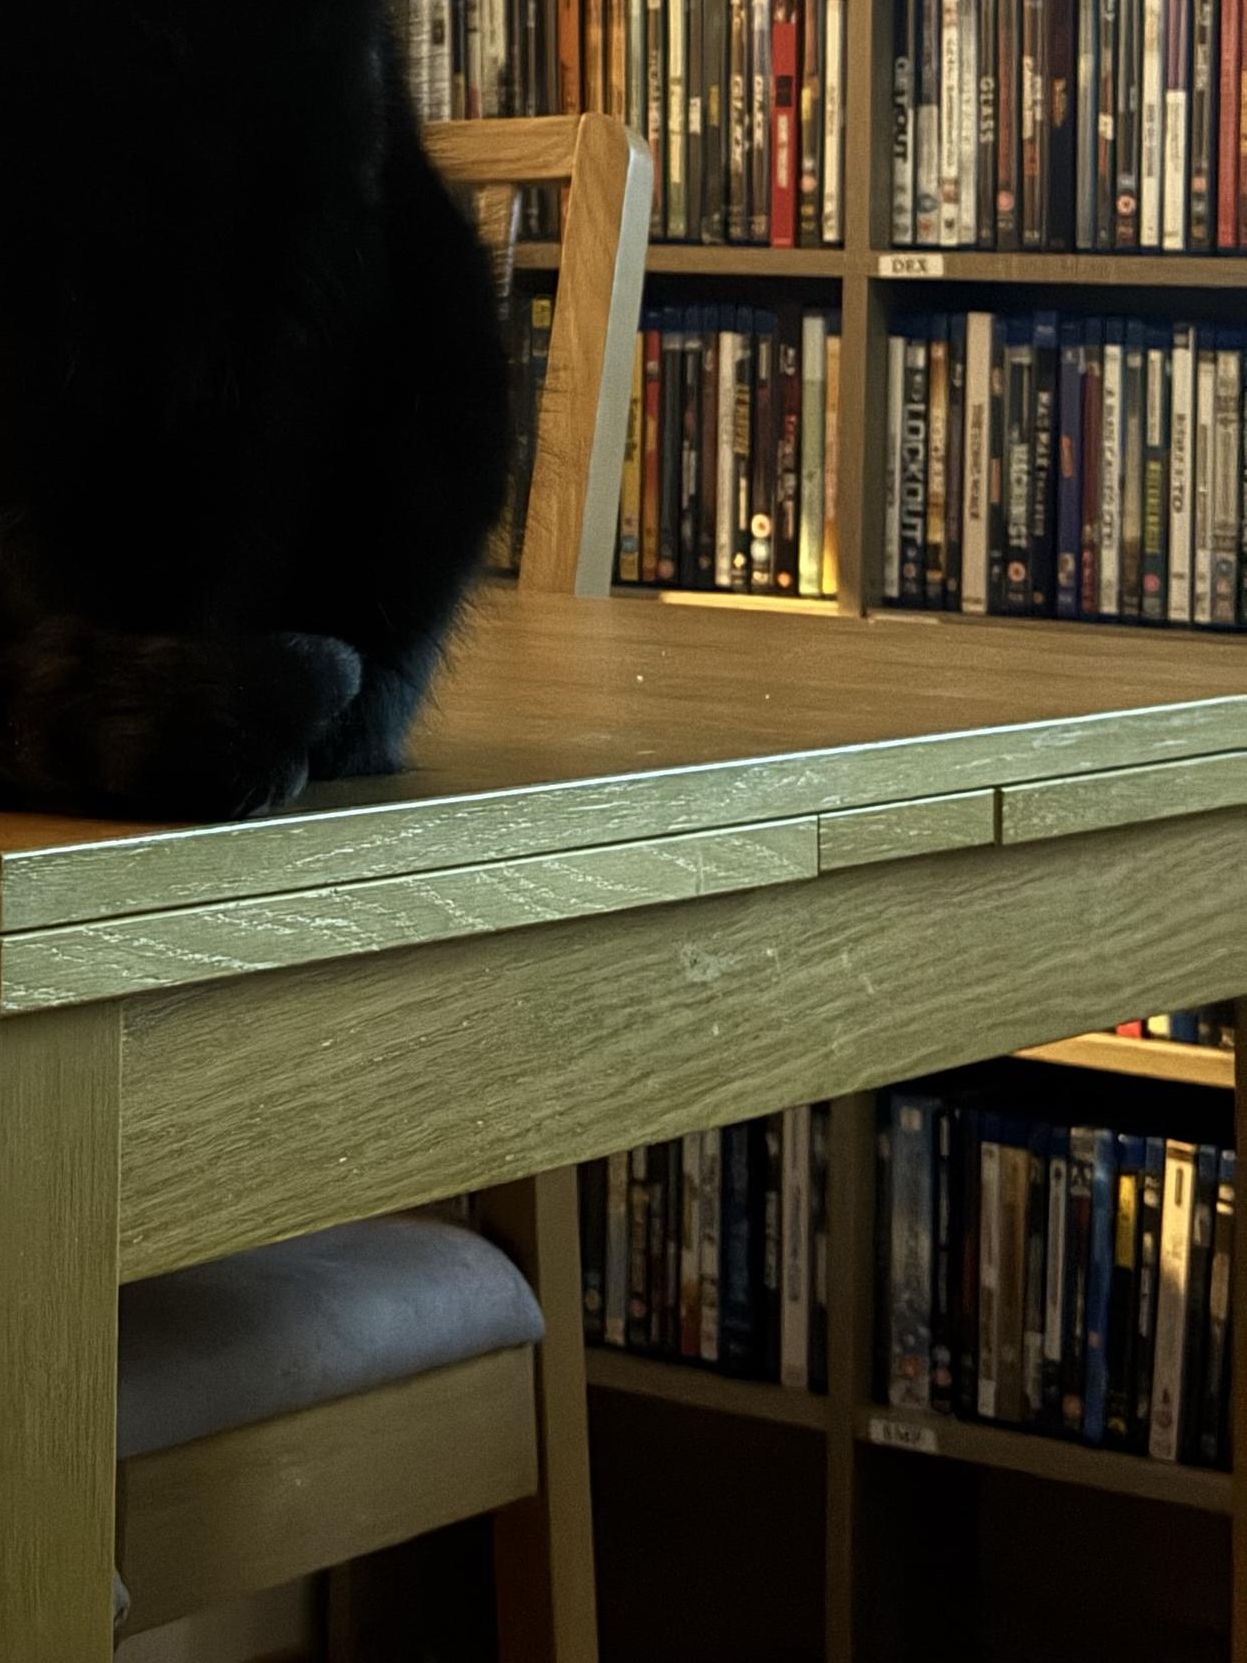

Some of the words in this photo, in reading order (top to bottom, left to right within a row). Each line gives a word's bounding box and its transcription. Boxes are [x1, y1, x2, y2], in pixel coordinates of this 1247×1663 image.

[894, 56, 909, 108] GET
[980, 77, 994, 143] GLASS
[892, 111, 908, 163] OUT
[891, 257, 928, 274] DEX
[902, 403, 926, 546] LOCKOUT
[1008, 444, 1029, 548] MACHINIST
